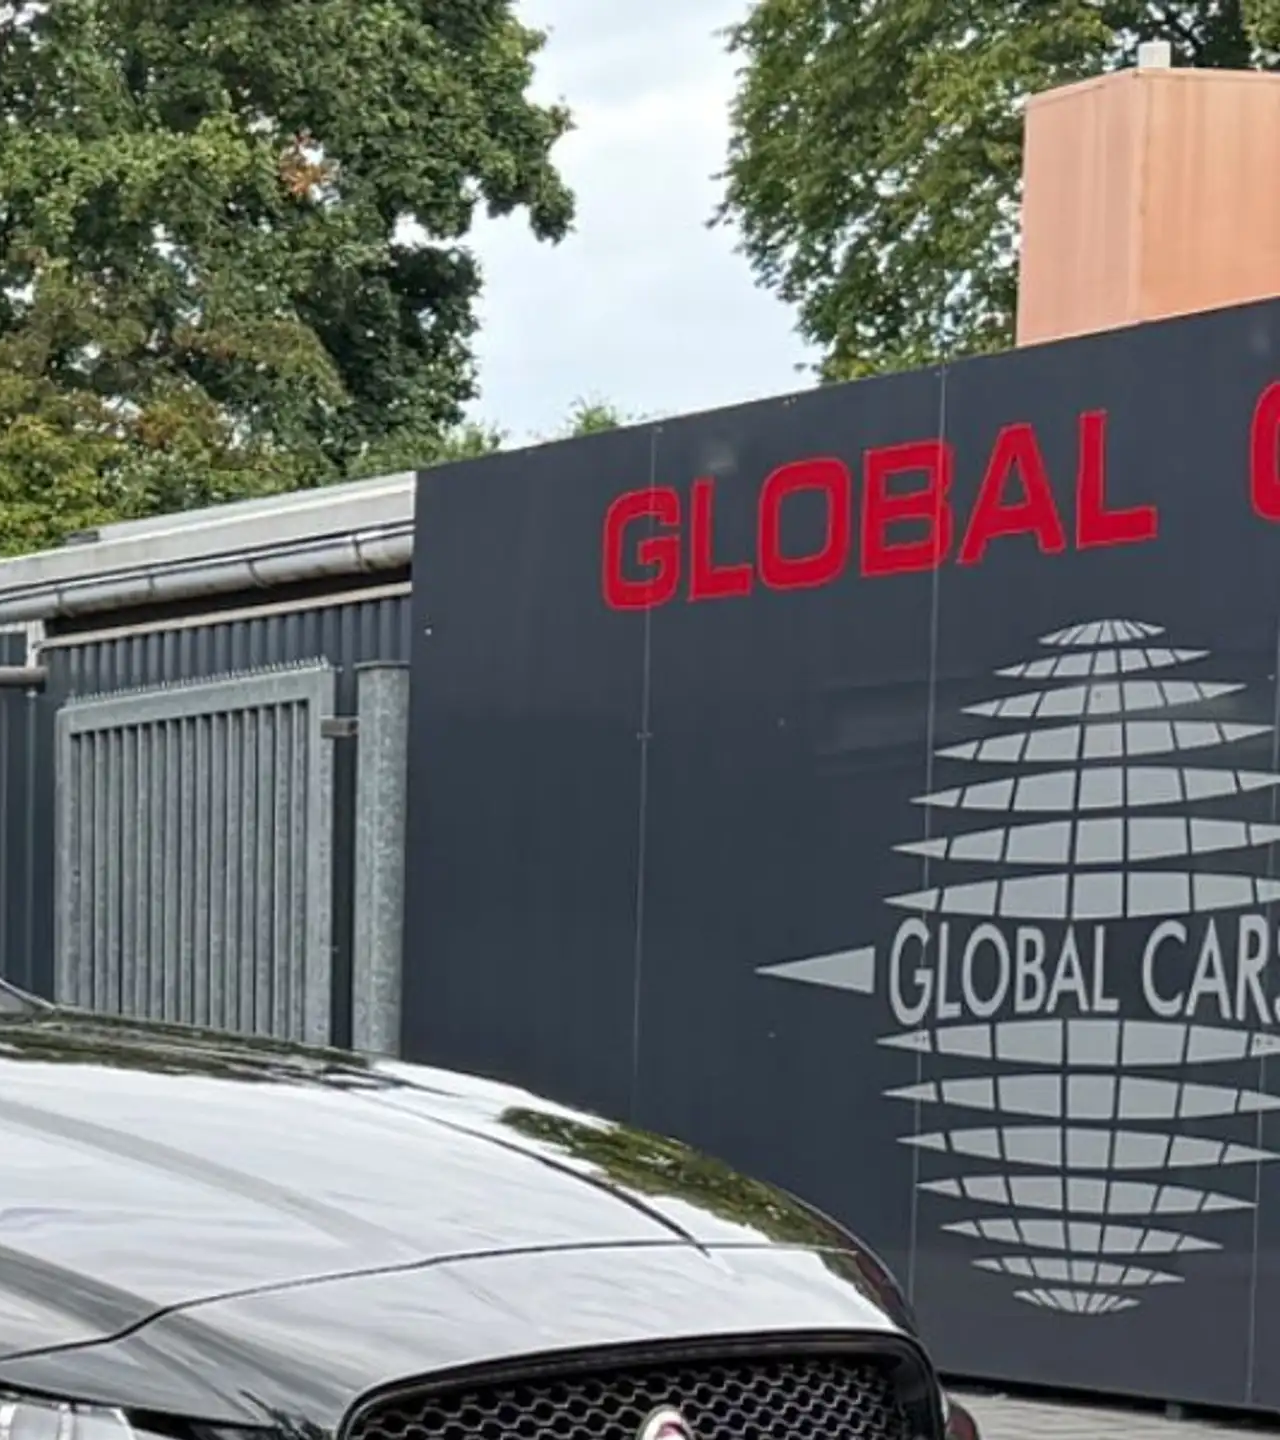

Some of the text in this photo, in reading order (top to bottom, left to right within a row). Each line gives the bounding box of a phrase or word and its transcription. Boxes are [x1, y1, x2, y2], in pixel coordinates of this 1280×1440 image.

[603, 409, 1157, 611] GLOBAL
[890, 913, 1280, 1025] GLOBAL CAR
